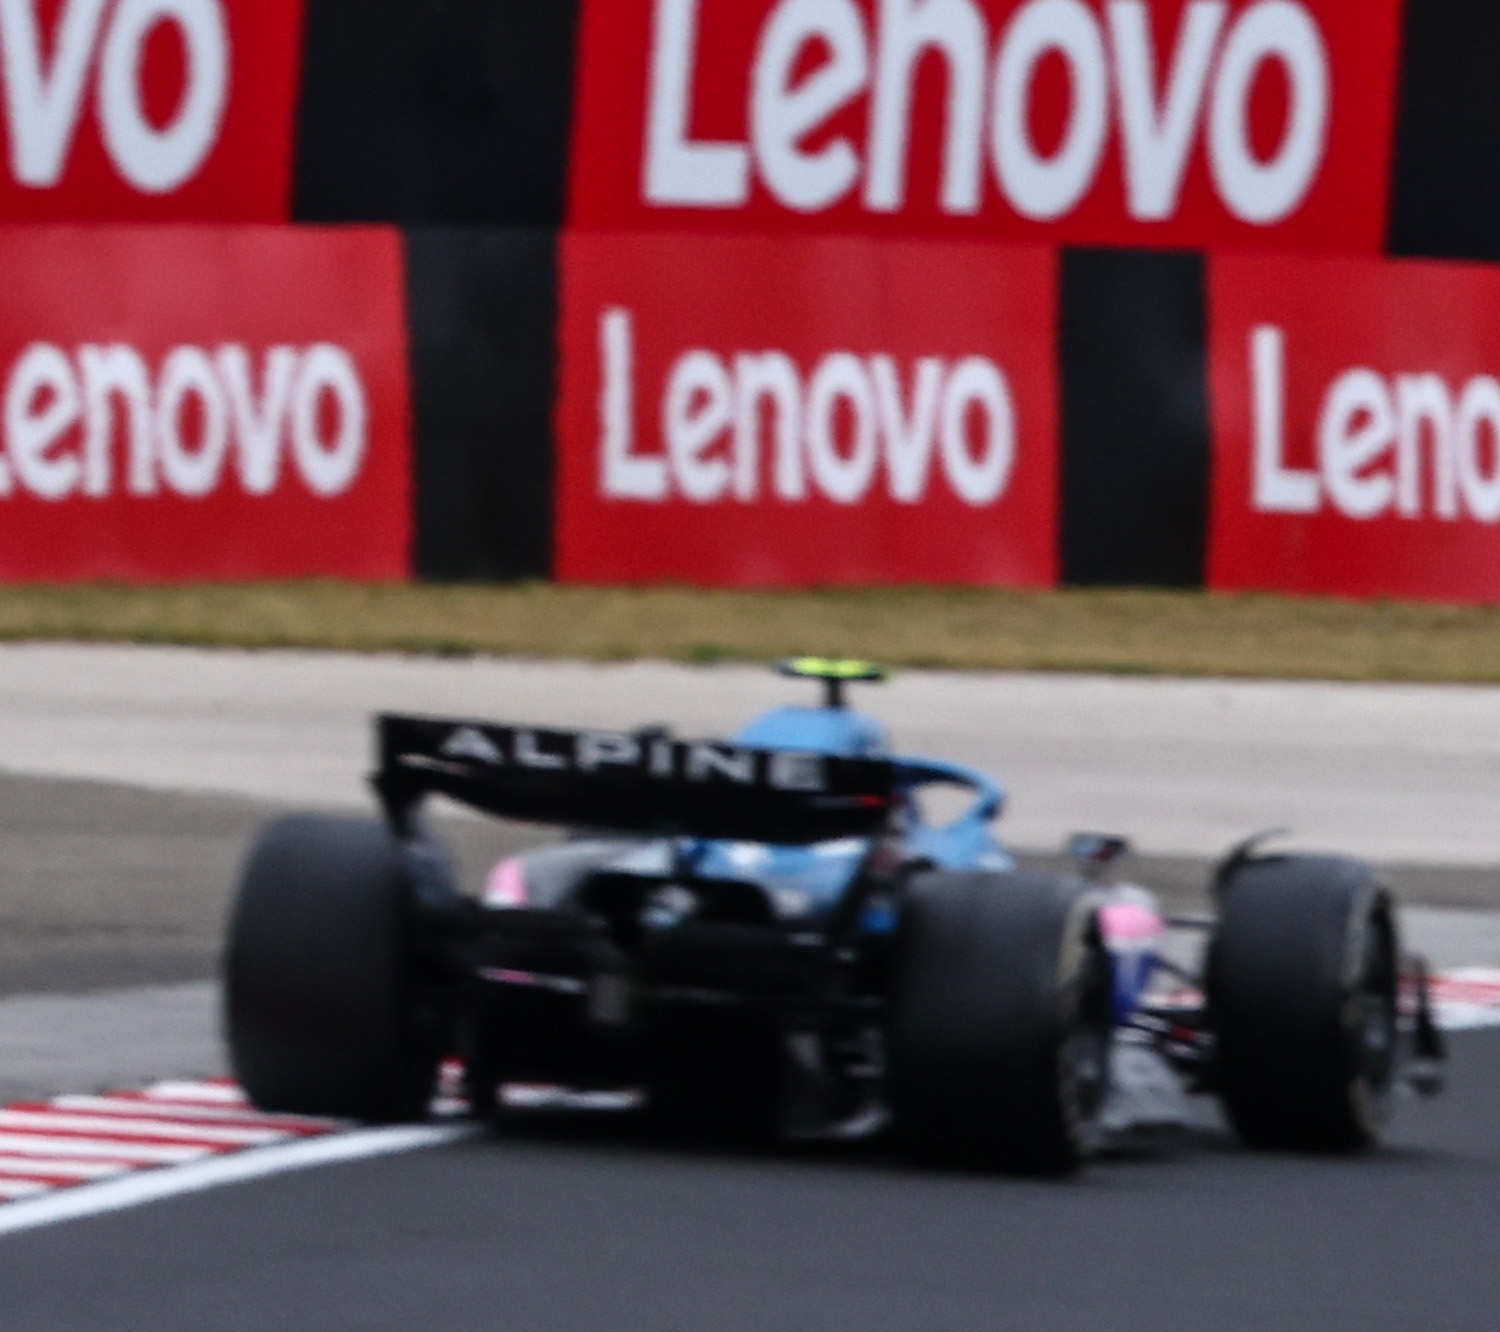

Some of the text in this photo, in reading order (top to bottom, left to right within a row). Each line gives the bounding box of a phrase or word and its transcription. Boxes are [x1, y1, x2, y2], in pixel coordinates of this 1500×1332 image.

[643, 0, 1329, 224] Lenovo
[0, 341, 368, 501] enovo
[599, 308, 1016, 505] Lenovo
[438, 726, 828, 792] ALPINE
